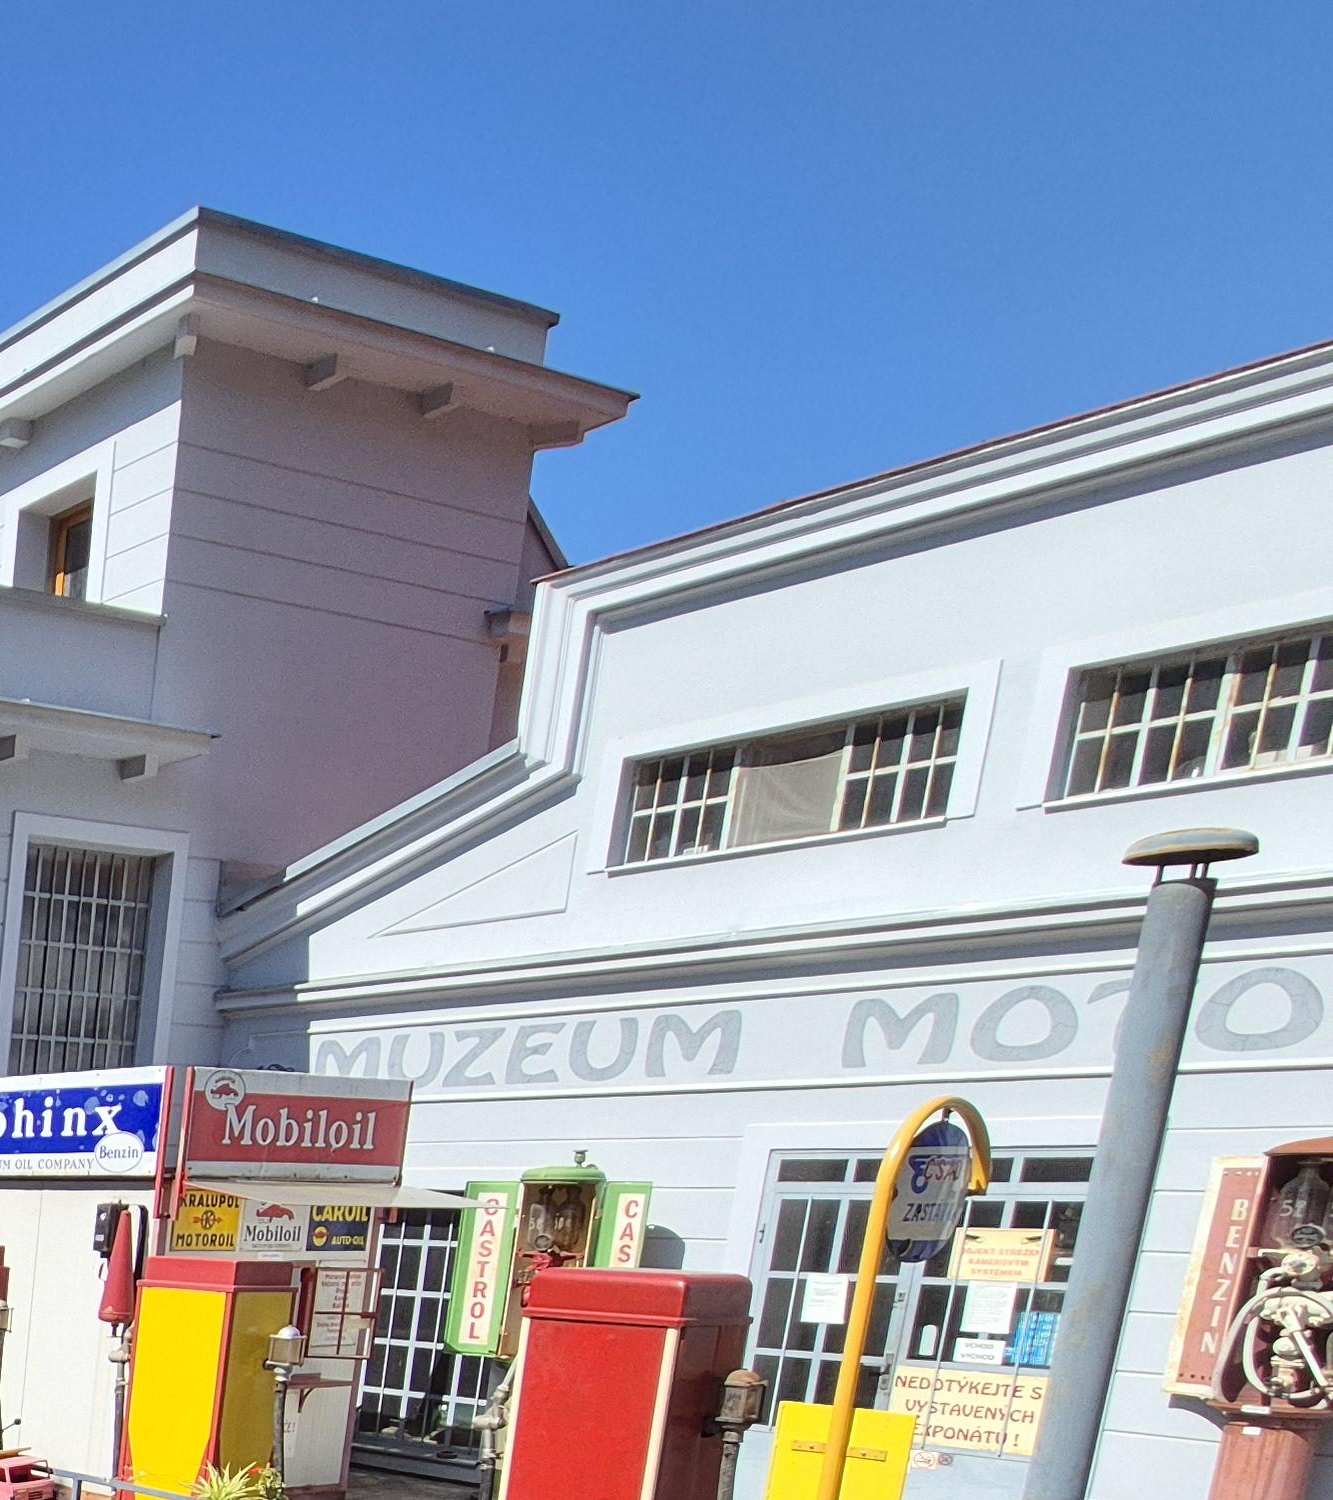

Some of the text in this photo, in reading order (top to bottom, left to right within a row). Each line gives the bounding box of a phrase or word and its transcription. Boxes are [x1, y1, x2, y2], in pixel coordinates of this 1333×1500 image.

[315, 967, 1324, 1088] MUZEUM MOO
[222, 1103, 376, 1150] Mobiloil
[99, 1145, 139, 1159] Benzin
[15, 1158, 33, 1169] OIL
[38, 1158, 95, 1169] COMPANY
[180, 1193, 240, 1208] KRALUPOL
[312, 1205, 369, 1222] CAROIL
[176, 1232, 235, 1247] MOTOROIL
[244, 1225, 302, 1242] Mobiloil
[468, 1198, 500, 1340] CASTROL
[1200, 1198, 1250, 1355] BENZIN
[895, 1375, 1025, 1399] NEDOTÝKEJTE
